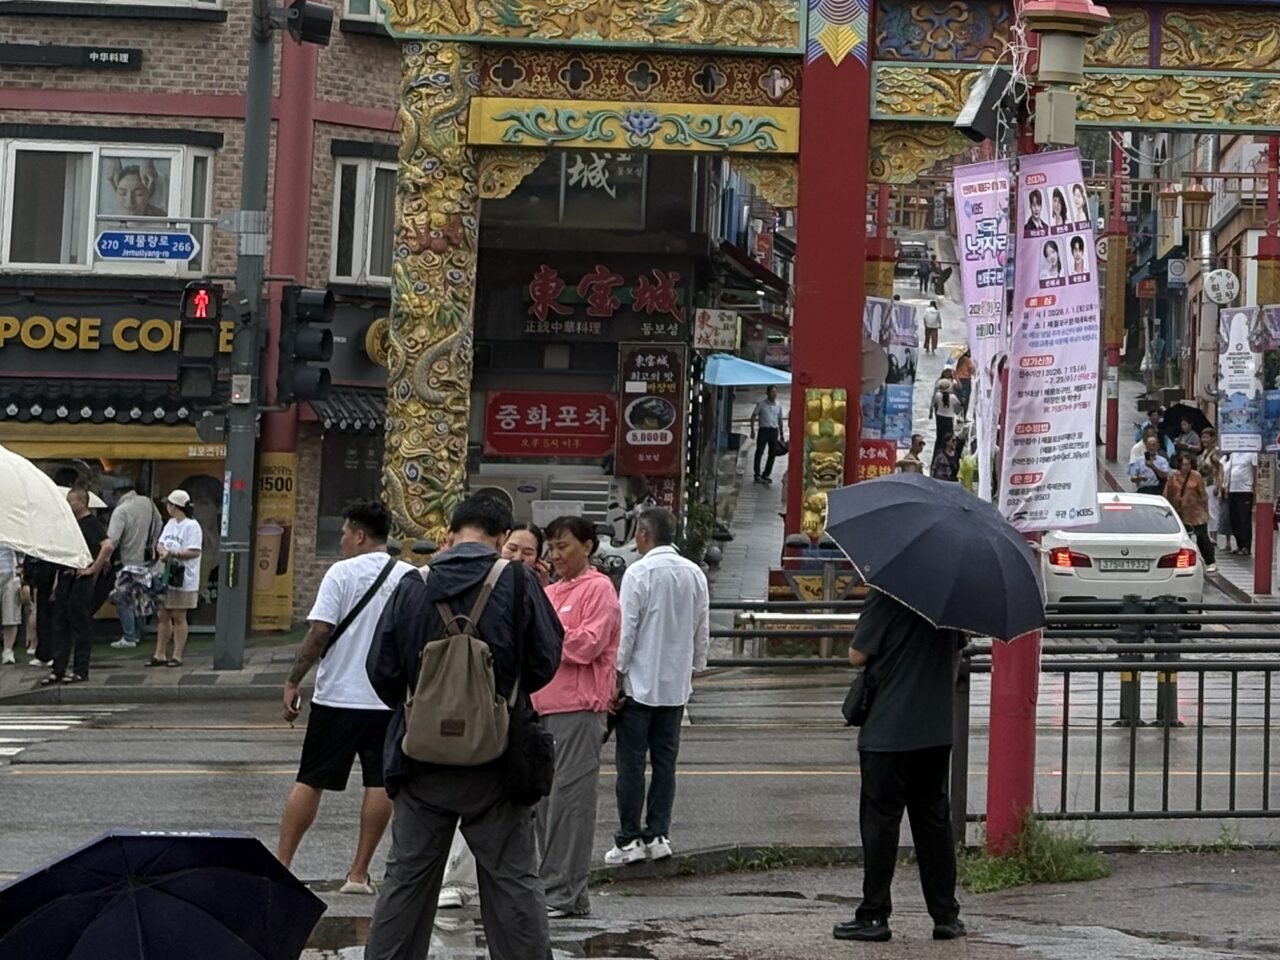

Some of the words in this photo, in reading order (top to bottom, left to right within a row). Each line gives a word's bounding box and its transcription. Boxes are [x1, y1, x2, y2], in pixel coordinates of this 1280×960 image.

[101, 240, 119, 250] 270
[124, 234, 170, 248] 제물량로
[172, 242, 191, 252] 266
[641, 322, 678, 336] 동보성
[630, 371, 661, 382] 최고의
[664, 371, 674, 382] 맛
[495, 403, 611, 431] 중화포차
[1076, 508, 1094, 517] KBS
